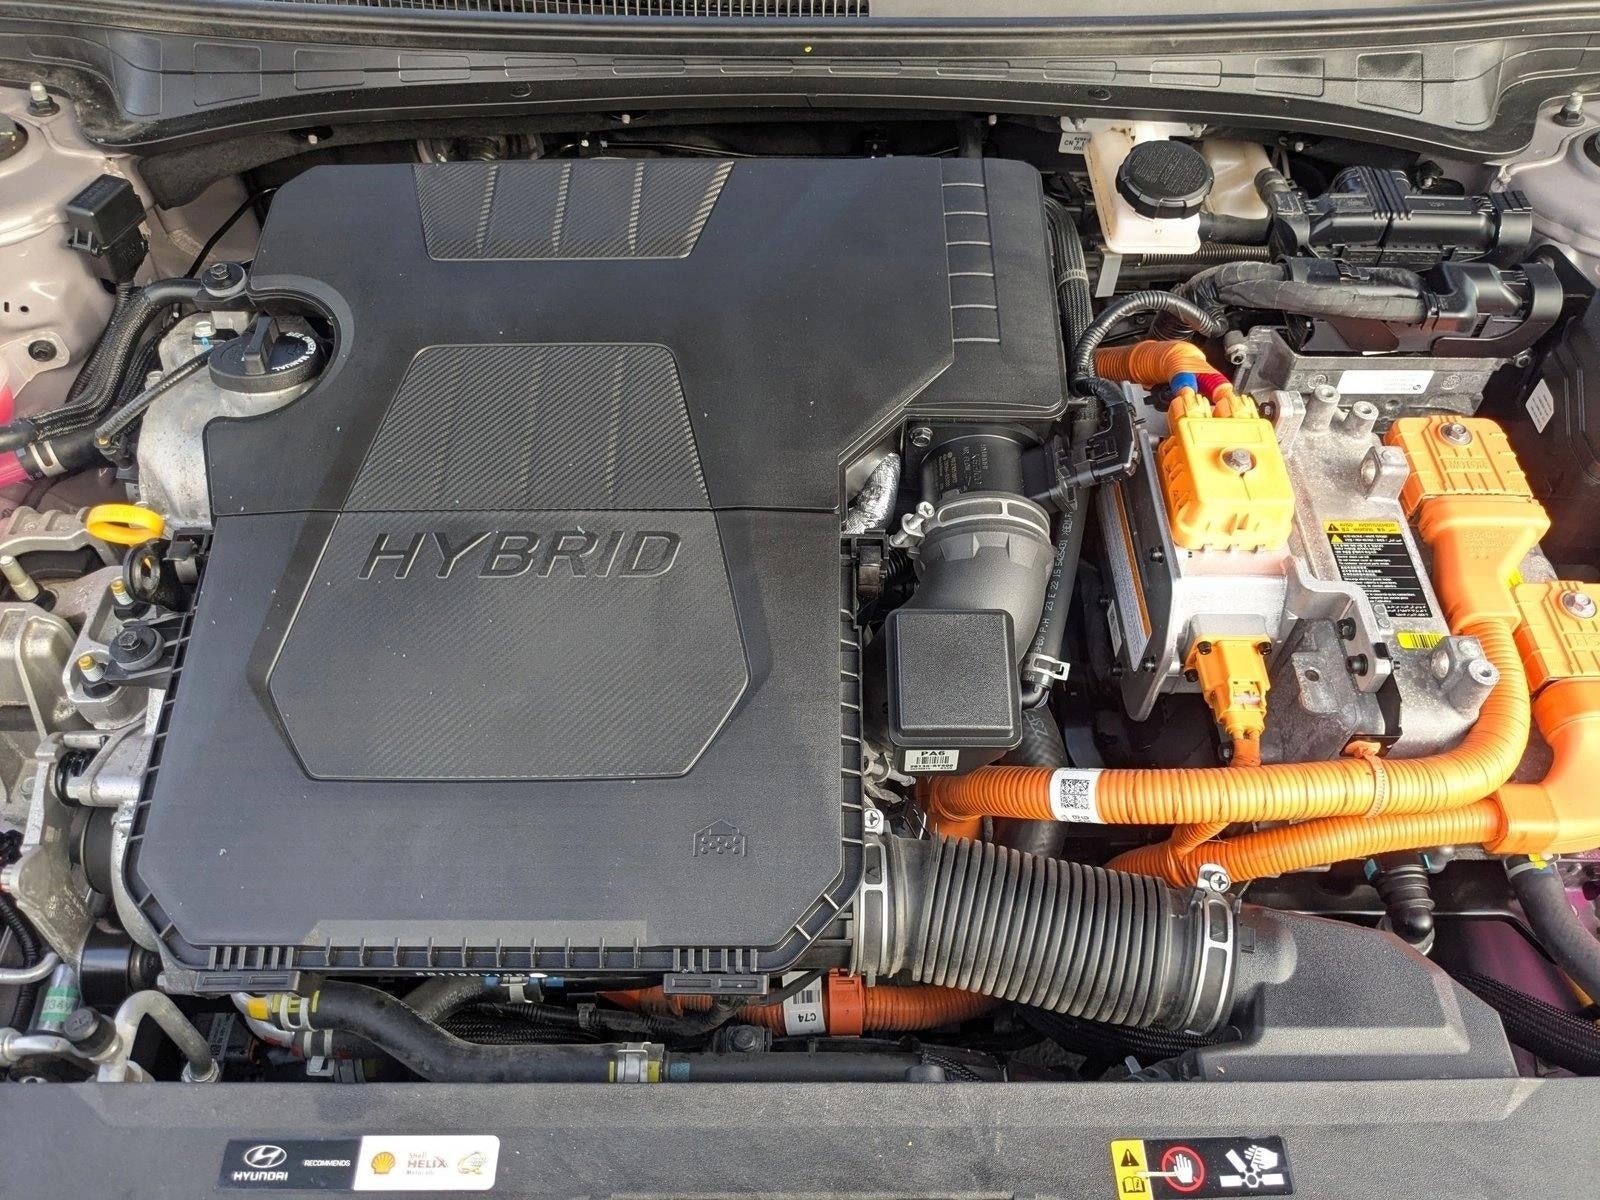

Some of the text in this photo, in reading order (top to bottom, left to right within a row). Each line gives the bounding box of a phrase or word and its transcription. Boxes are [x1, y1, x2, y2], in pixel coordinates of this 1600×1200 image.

[357, 530, 682, 580] HYBRID
[797, 1012, 817, 1023] C74
[302, 1159, 351, 1167] RECOMMENDS
[407, 1156, 448, 1169] HELIX
[232, 1171, 289, 1181] HYUNDAI
